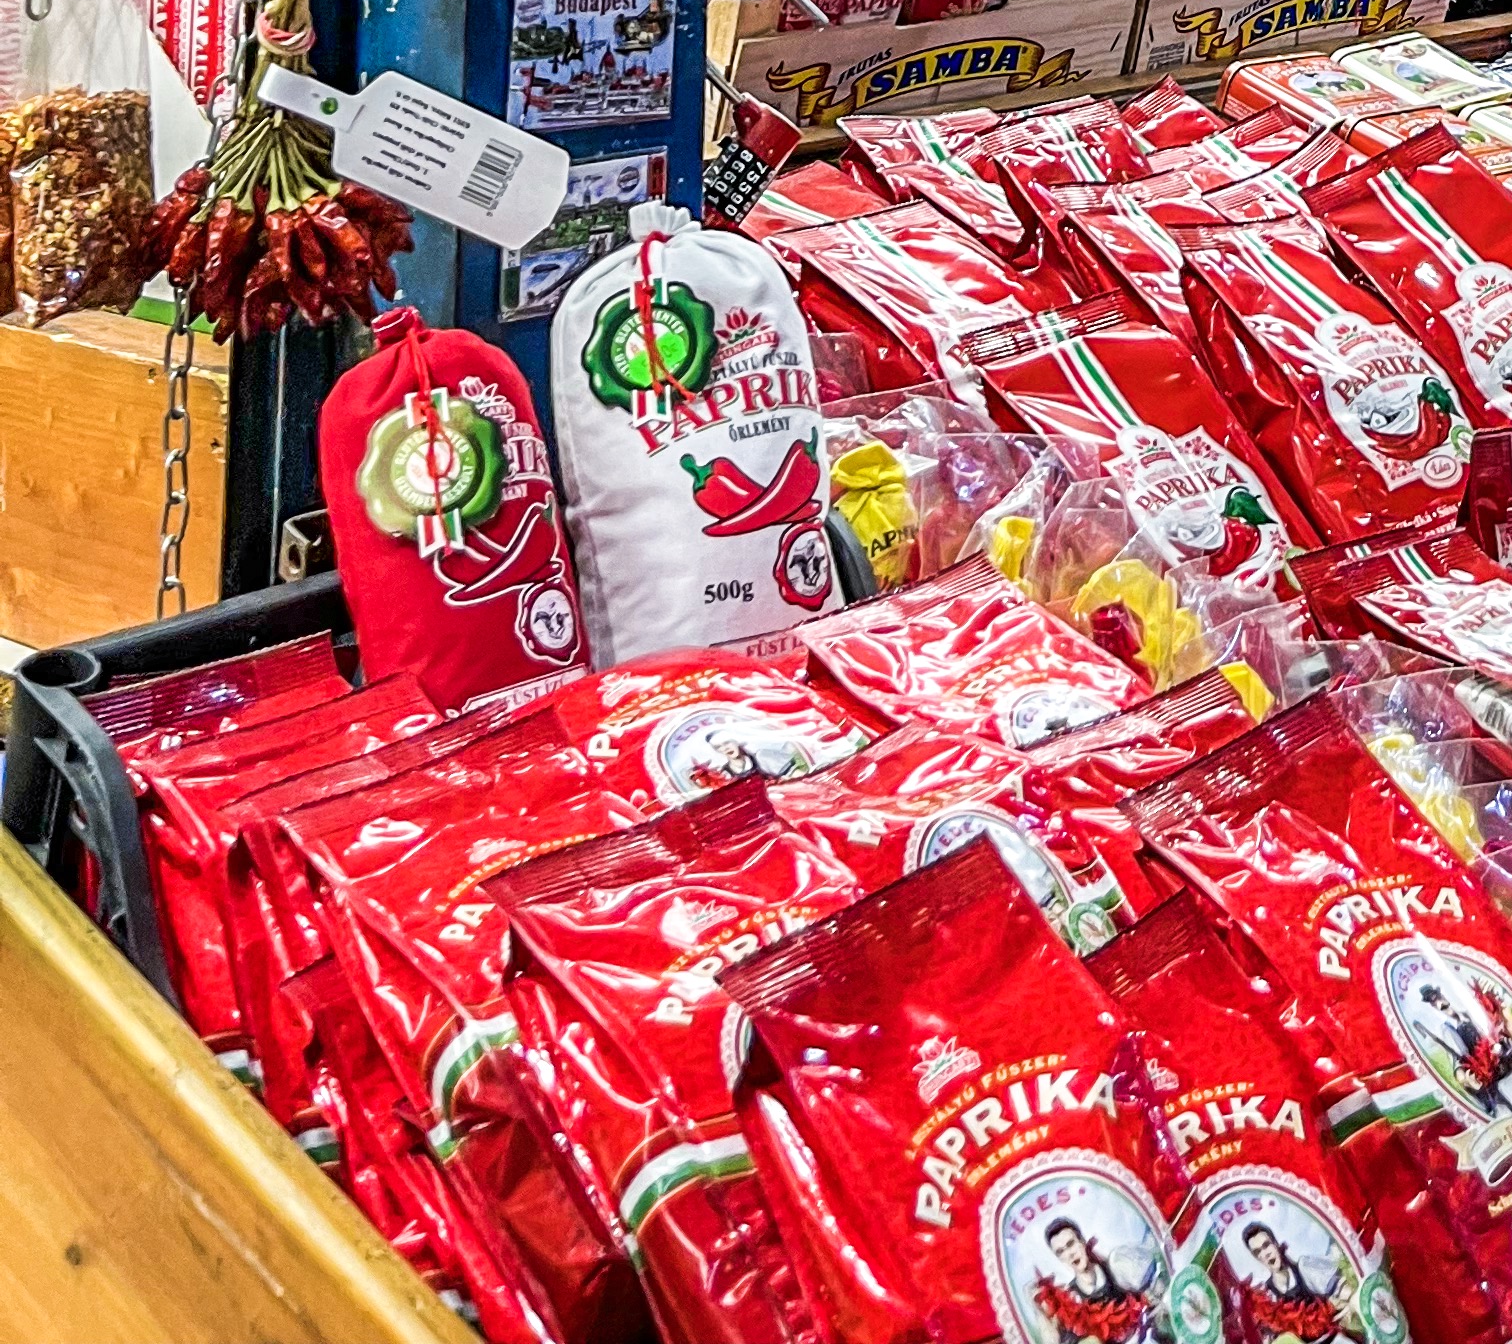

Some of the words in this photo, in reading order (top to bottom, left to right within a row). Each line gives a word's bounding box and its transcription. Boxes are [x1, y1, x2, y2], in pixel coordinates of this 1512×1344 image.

[837, 47, 894, 85] FRUTAS
[867, 44, 1020, 102] SAMBA
[1332, 355, 1437, 408] PAPRIKA
[728, 413, 791, 443] ŐRLEMÉNY
[1134, 462, 1248, 517] PAPRIKA
[703, 578, 755, 605] 500g
[1317, 884, 1465, 981] PAPRIKA
[915, 1068, 1120, 1229] PAPRIKA
[1166, 1095, 1307, 1158] RIKA
